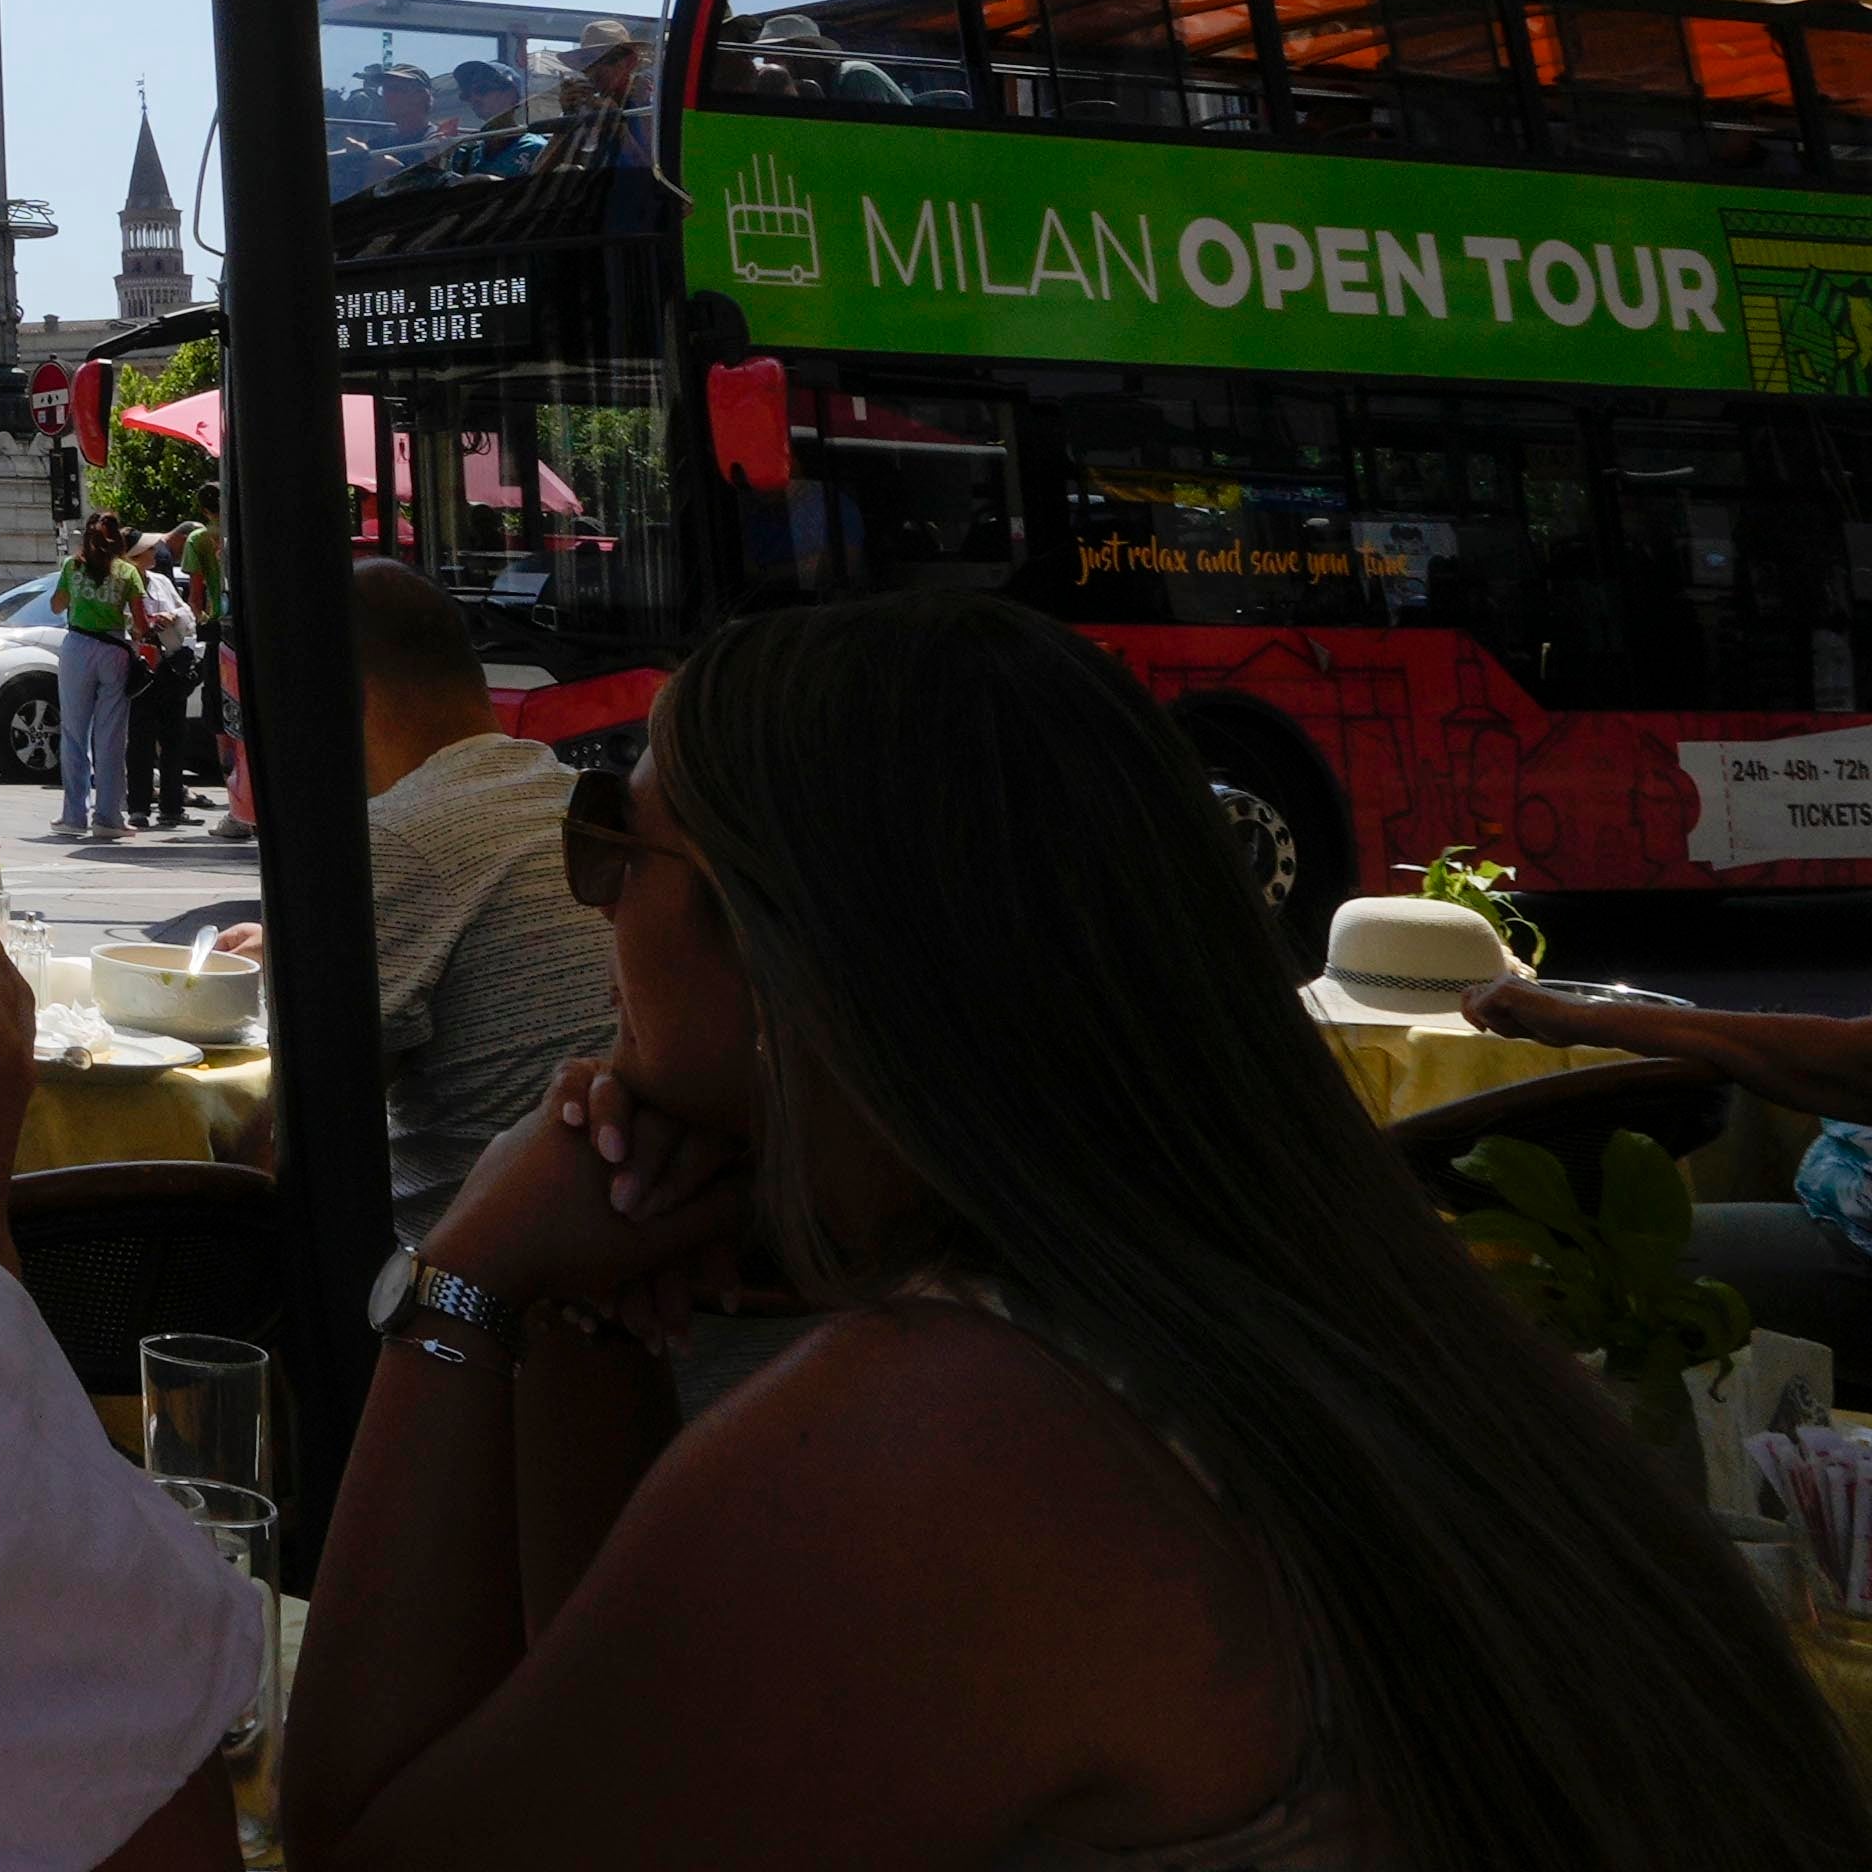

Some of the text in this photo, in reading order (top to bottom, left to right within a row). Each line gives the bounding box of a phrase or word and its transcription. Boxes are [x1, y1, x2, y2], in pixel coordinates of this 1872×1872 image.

[861, 194, 1727, 334] MILAN OPEN TOUR
[430, 277, 526, 310] DESIGN
[367, 313, 483, 346] LEISURE
[1075, 531, 1129, 585] just
[1127, 534, 1190, 575] relax
[1196, 538, 1246, 575] and
[1250, 548, 1301, 575] save
[1732, 760, 1769, 781] 24h
[1784, 759, 1818, 780] 48h
[1833, 759, 1871, 781] 72h
[1787, 803, 1872, 827] TICKETS
